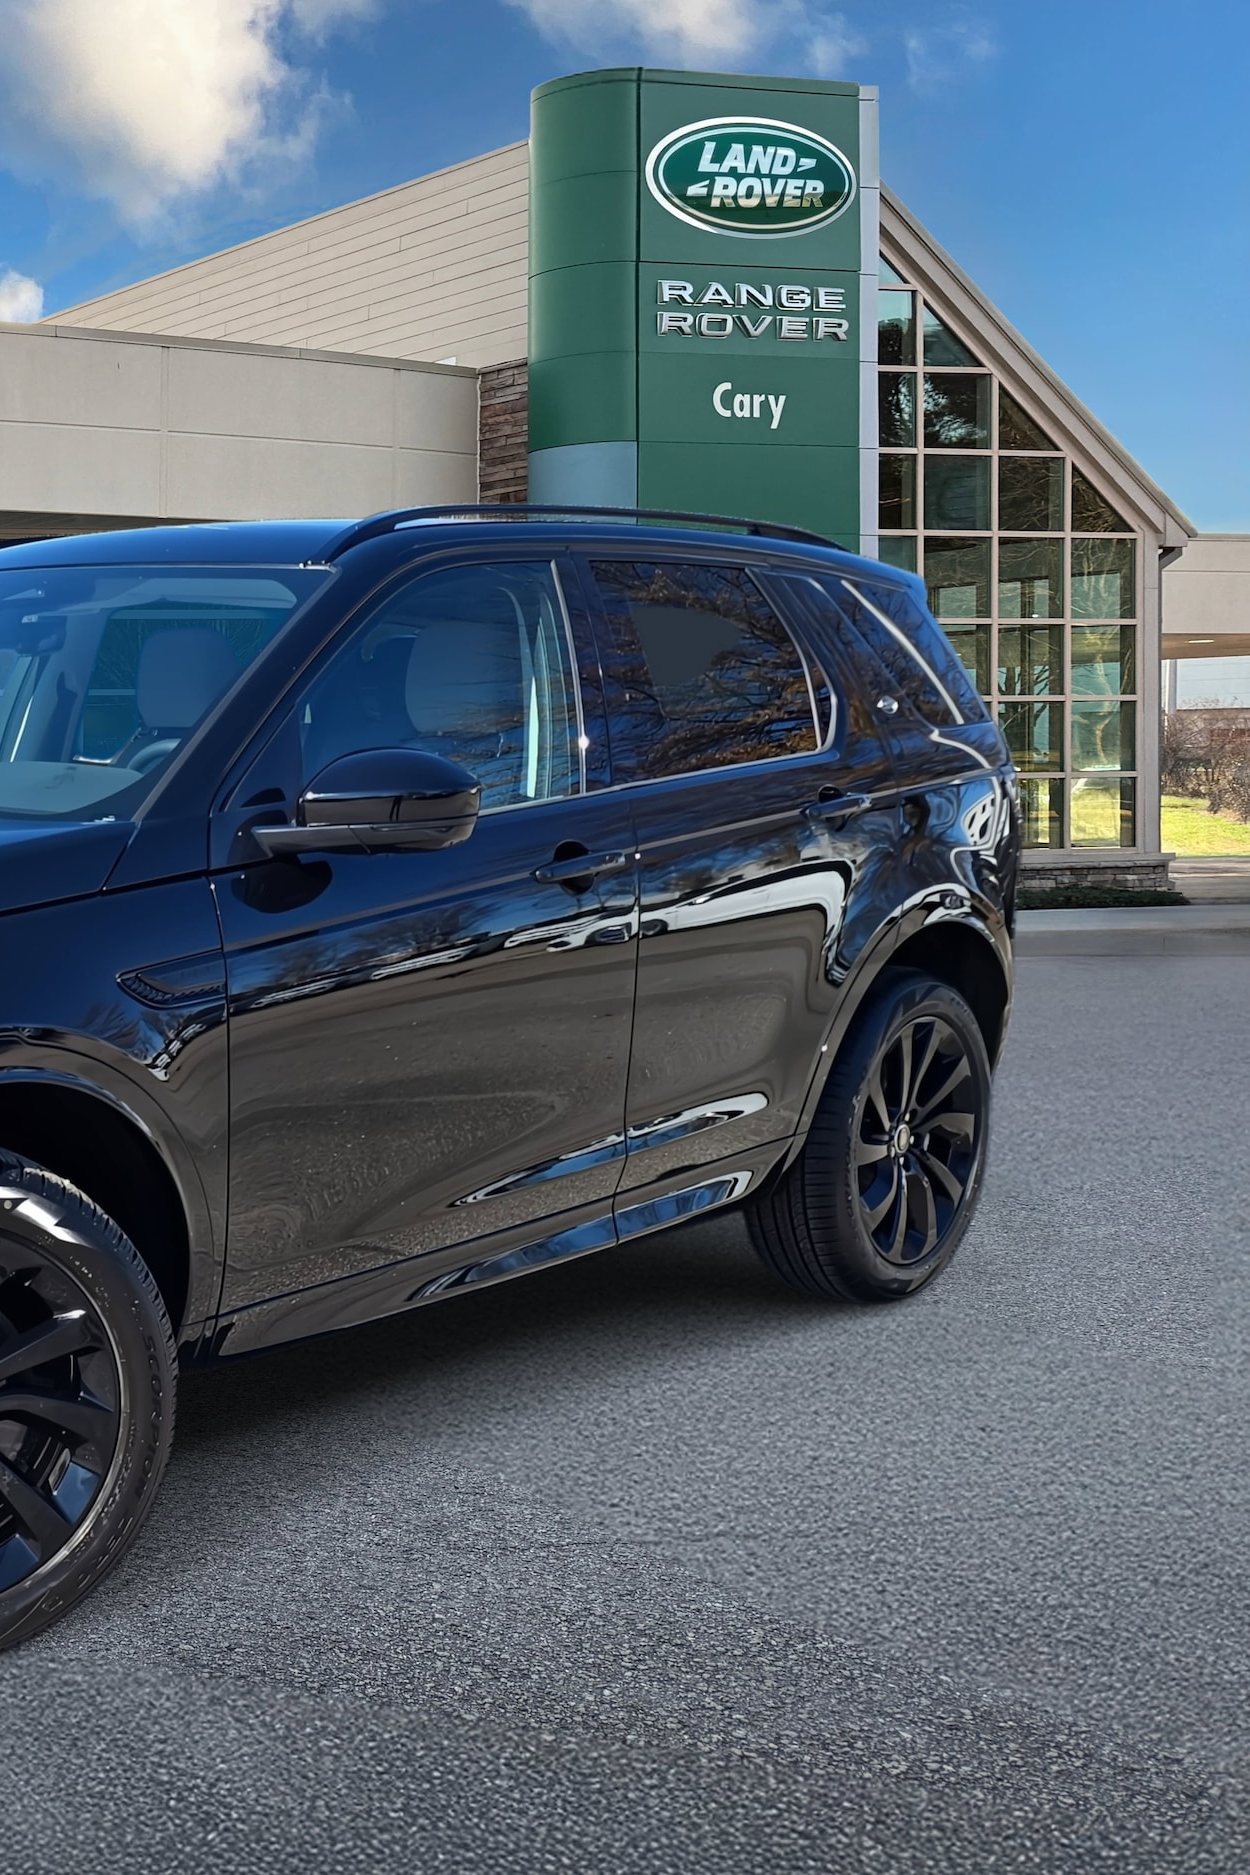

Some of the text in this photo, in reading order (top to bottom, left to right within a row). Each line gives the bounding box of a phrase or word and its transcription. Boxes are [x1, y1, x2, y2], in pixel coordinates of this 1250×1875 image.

[697, 141, 797, 175] LAND
[710, 176, 824, 208] ROVER
[657, 280, 846, 312] RANGE
[657, 311, 849, 342] ROVER
[712, 381, 787, 430] Cary
